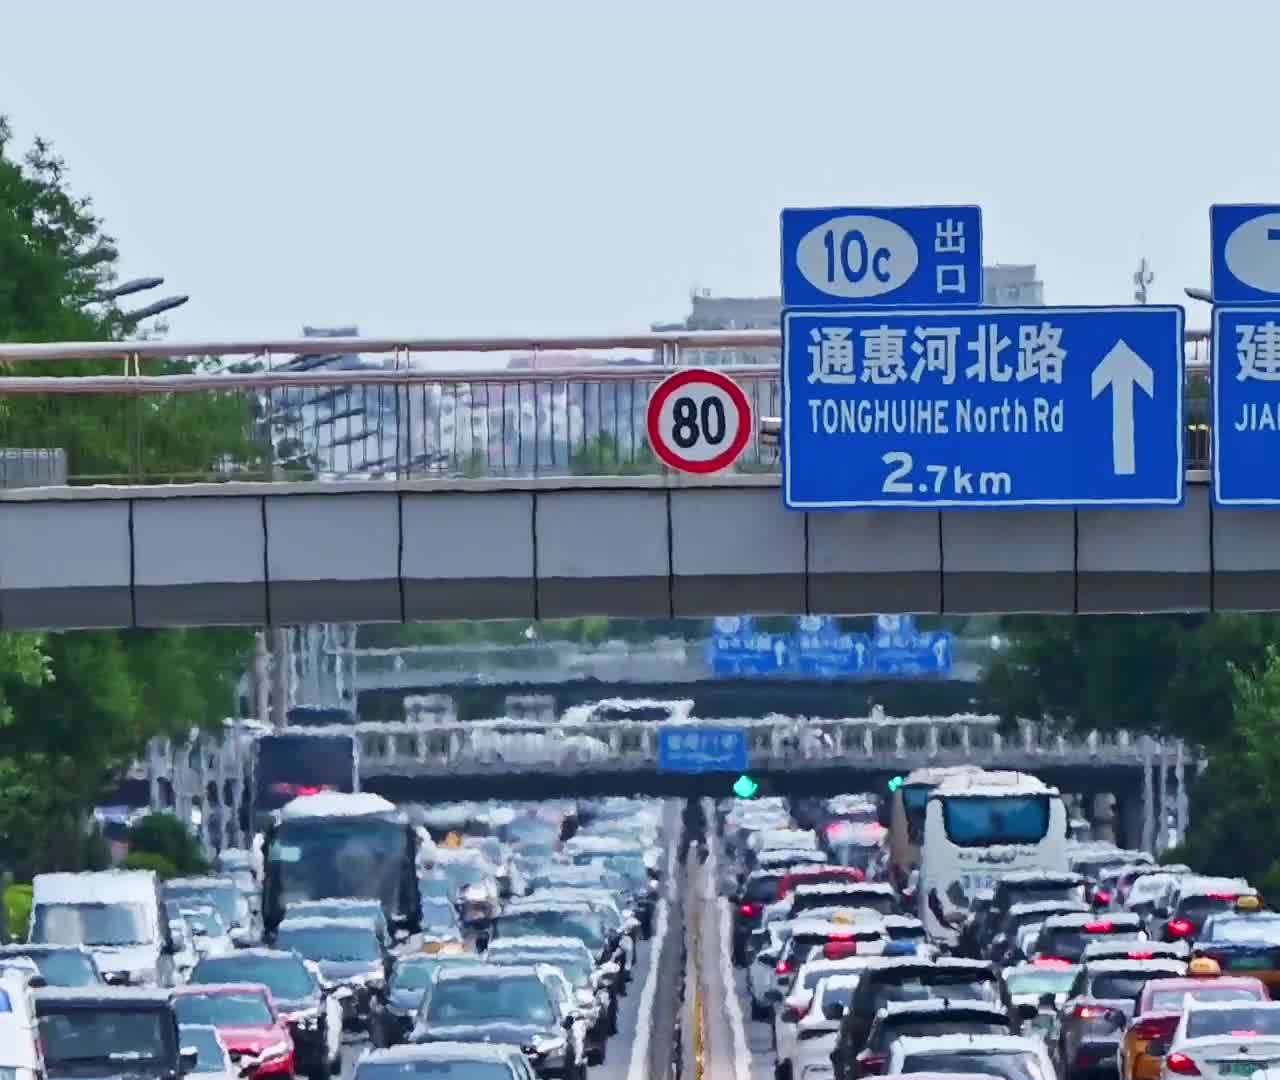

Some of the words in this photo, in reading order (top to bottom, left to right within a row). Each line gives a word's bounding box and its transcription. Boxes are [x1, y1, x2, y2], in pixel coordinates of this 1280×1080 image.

[823, 228, 892, 284] 10c
[934, 219, 966, 293] 出口
[807, 321, 1067, 385] 通惠河北路
[671, 396, 726, 449] 80
[808, 398, 949, 434] TONGHUIHE
[956, 398, 1028, 433] North
[1034, 397, 1064, 433] Rd
[882, 451, 1011, 495] 2.7km
